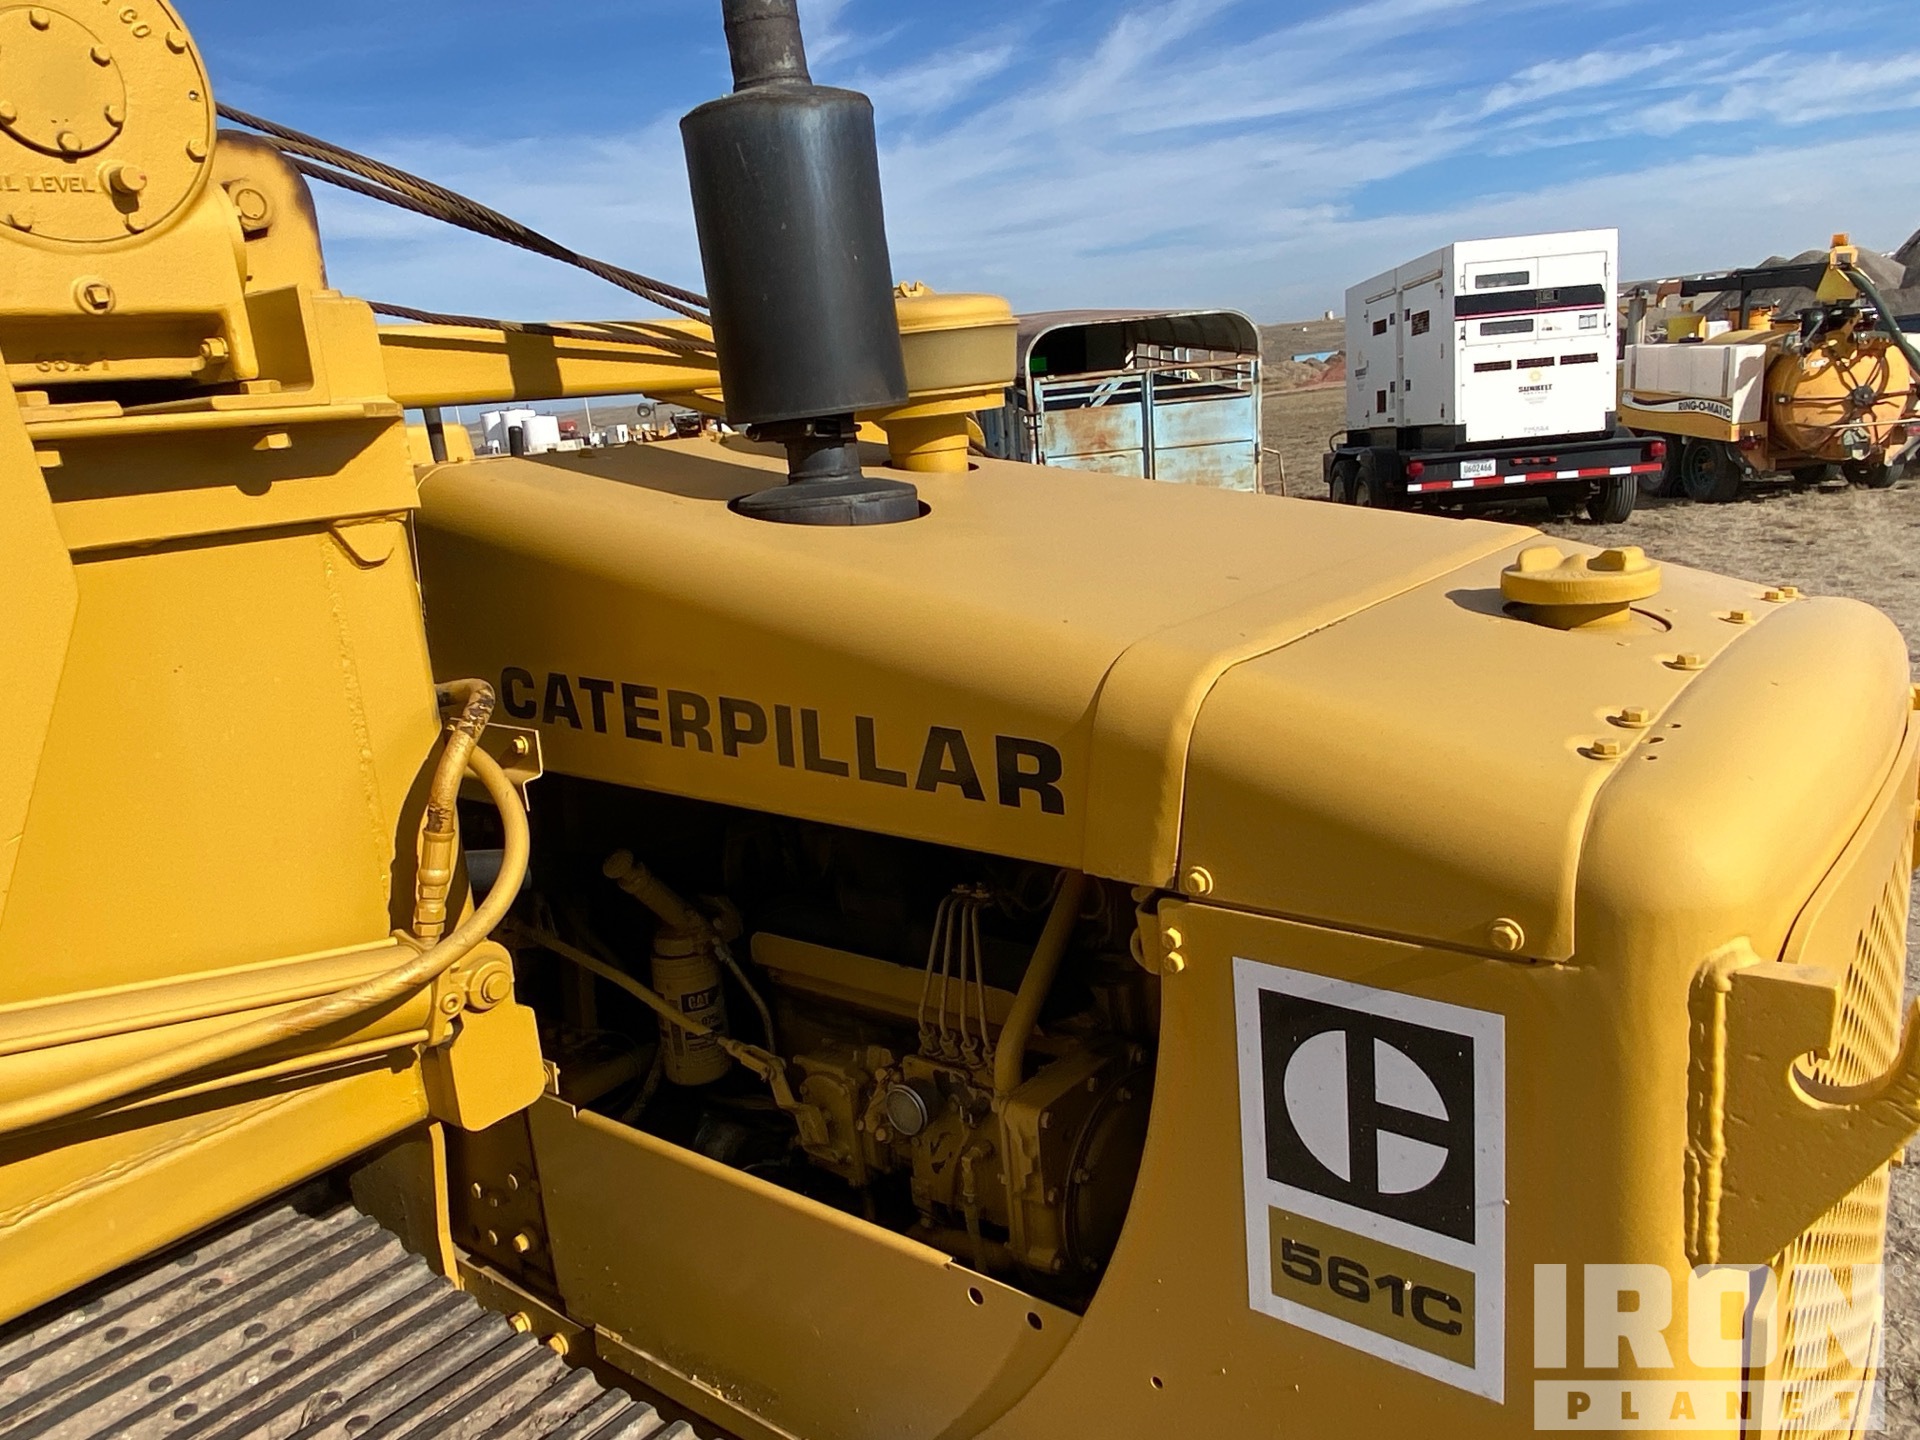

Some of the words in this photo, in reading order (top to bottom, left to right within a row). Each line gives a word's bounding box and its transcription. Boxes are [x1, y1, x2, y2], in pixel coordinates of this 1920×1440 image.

[25, 175, 95, 192] LEVEL
[1678, 402, 1731, 418] RING-O-MATIC
[501, 666, 1066, 815] CATERPILLAR
[688, 993, 708, 1008] CAT
[1281, 1236, 1463, 1336] 561C
